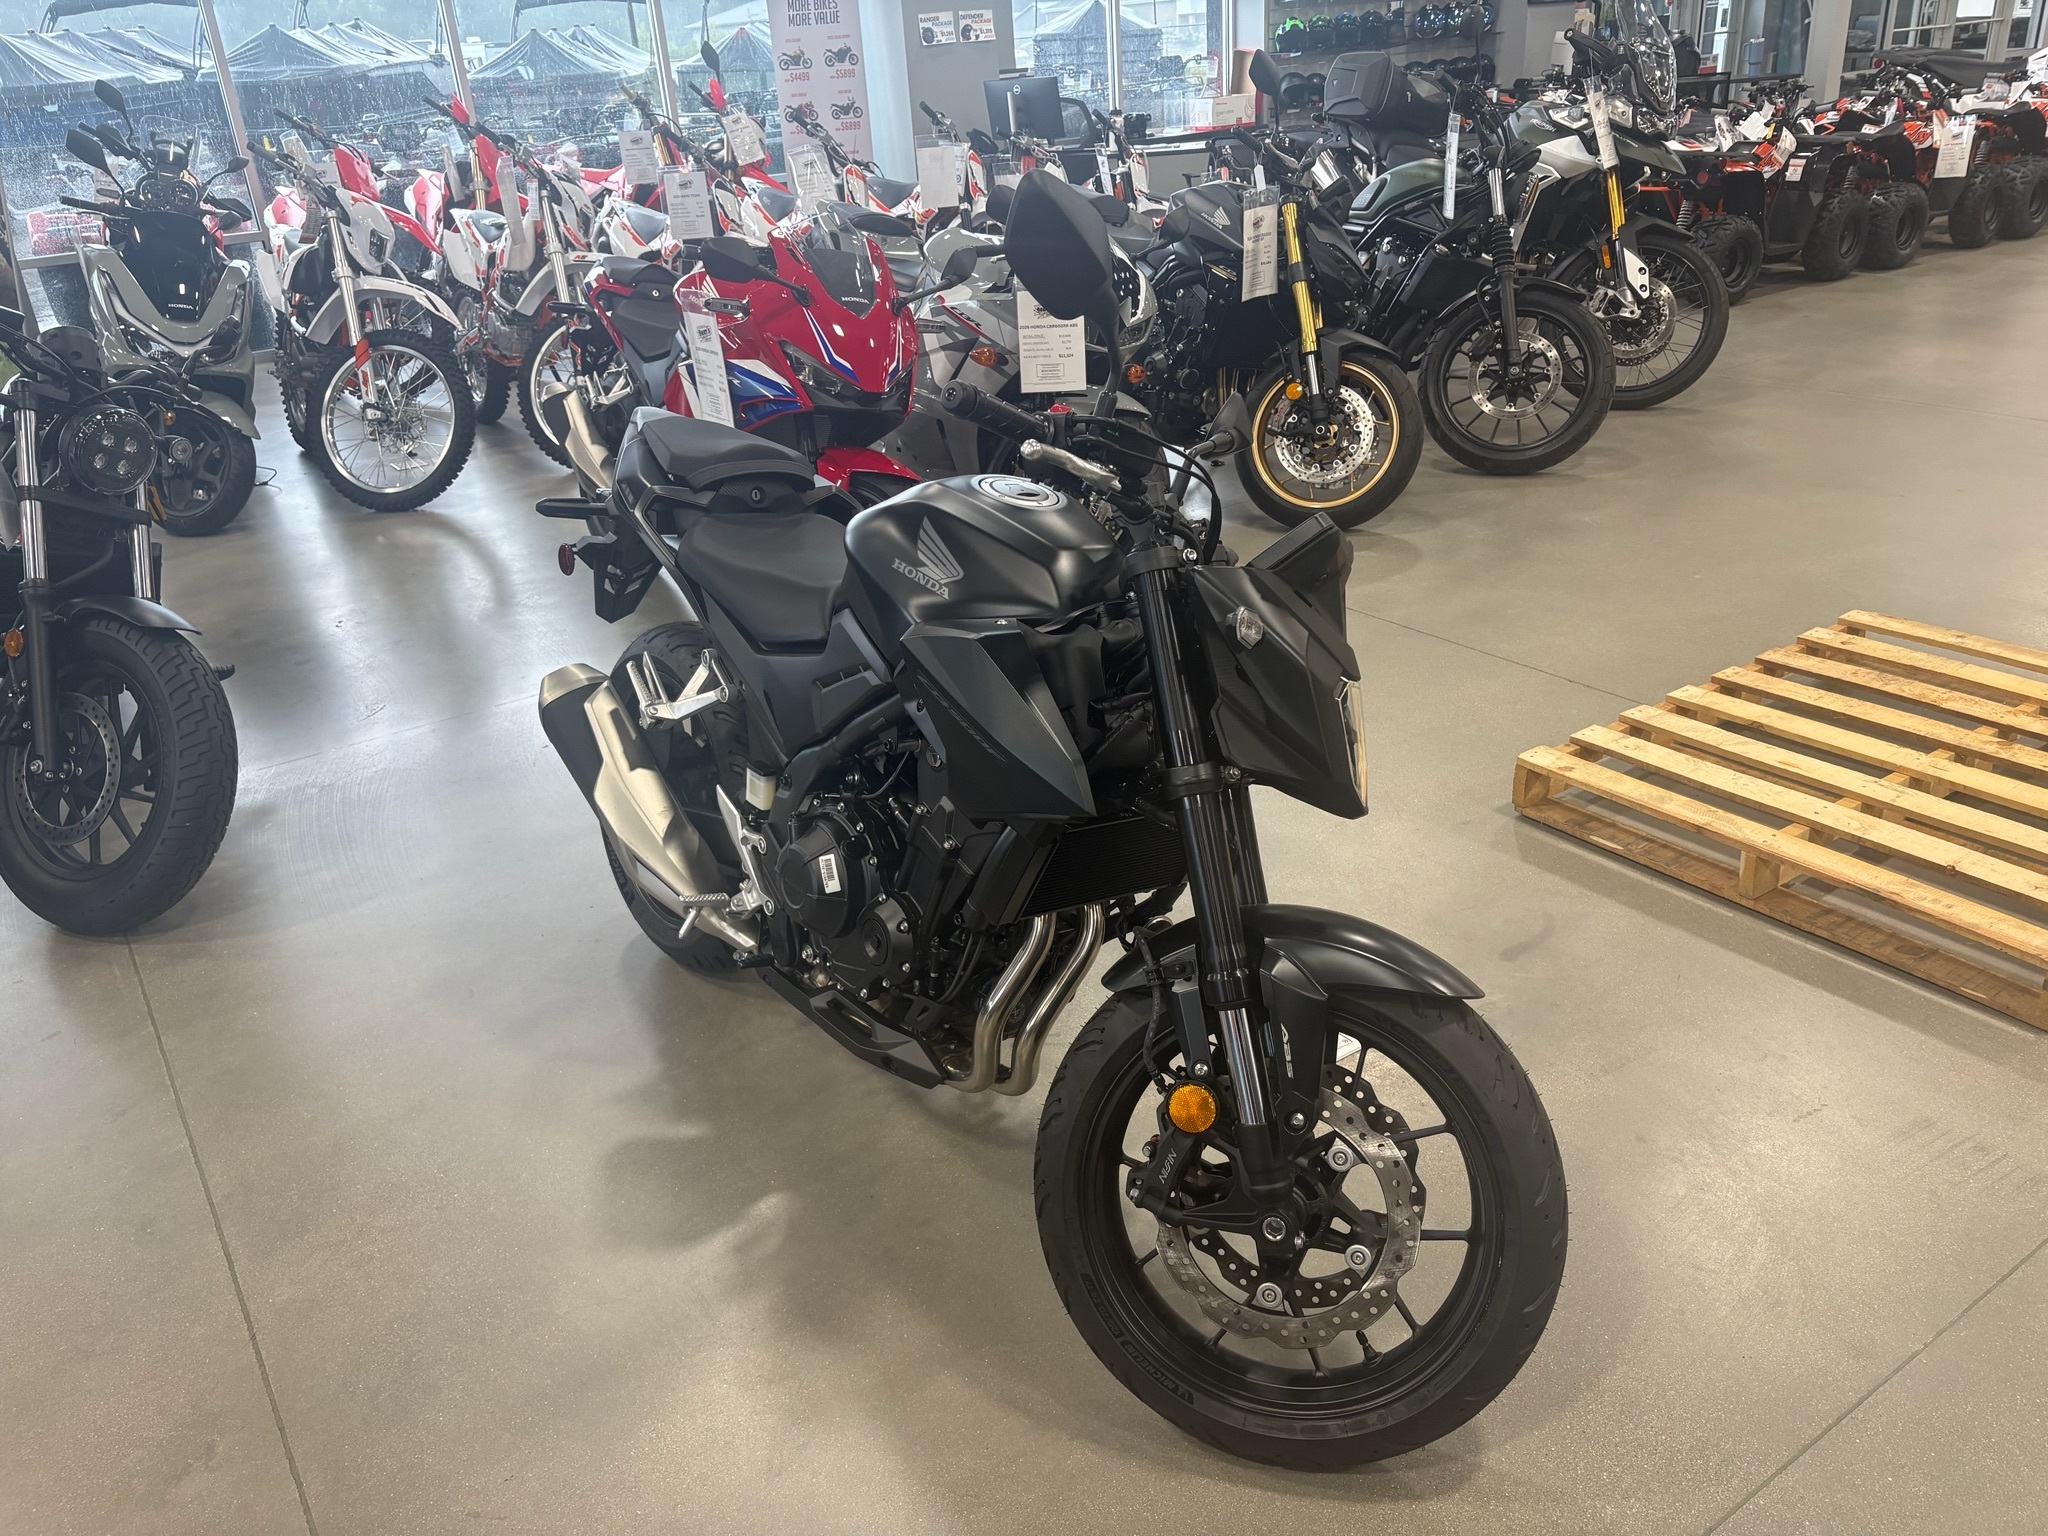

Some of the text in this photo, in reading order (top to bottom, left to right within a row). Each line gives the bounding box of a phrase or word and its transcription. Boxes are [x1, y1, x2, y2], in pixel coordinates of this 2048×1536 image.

[787, 0, 838, 12] MORE BIKES
[788, 10, 841, 27] MORE VALUE
[790, 72, 810, 82] $4499
[836, 68, 856, 79] $5899
[841, 121, 861, 131] $6899
[1530, 119, 1557, 133] TRIUMPH
[1201, 212, 1223, 230] HONDA
[841, 296, 870, 305] HONDA
[950, 306, 982, 329] CBR
[891, 558, 949, 600] HONDA
[1280, 1022, 1294, 1079] ABS
[1158, 1147, 1178, 1185] NISSIN
[1124, 1342, 1177, 1391] MICHELIN
